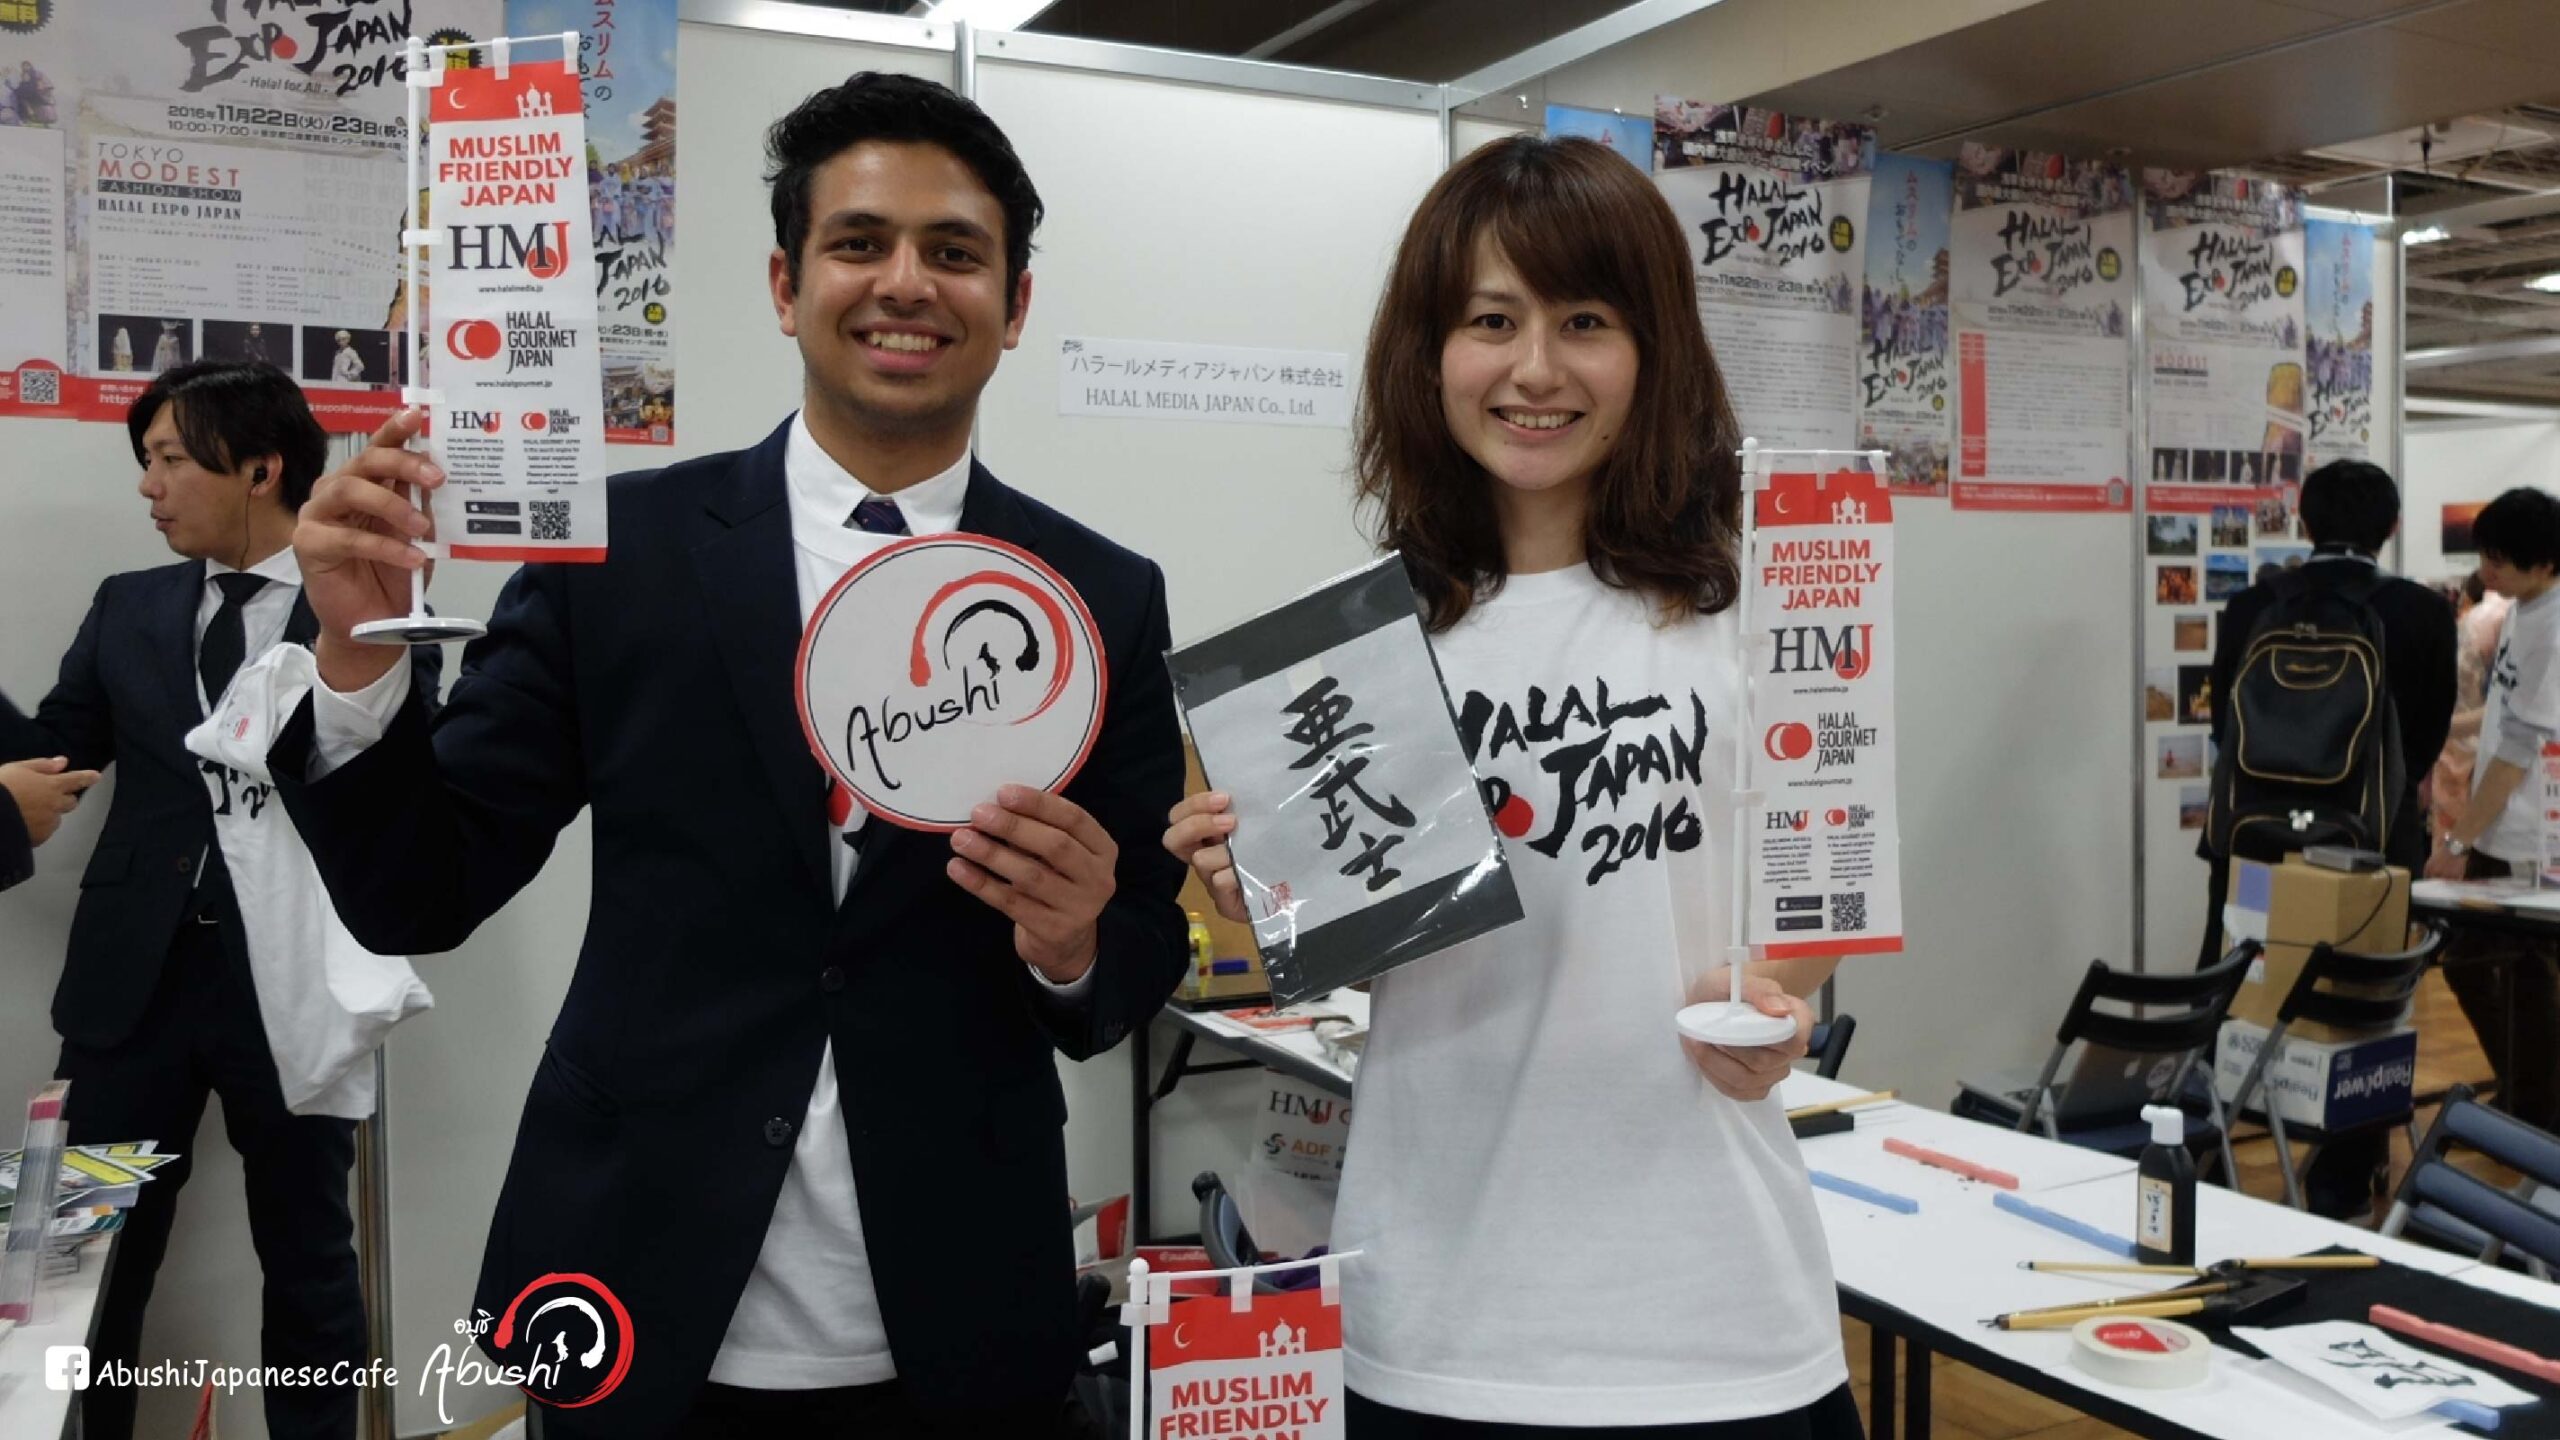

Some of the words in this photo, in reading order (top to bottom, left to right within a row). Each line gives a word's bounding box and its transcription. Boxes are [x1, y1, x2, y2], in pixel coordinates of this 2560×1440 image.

[293, 0, 412, 75] JAPAN
[284, 79, 302, 92] for
[97, 142, 185, 162] TOKYO
[450, 133, 561, 158] MUSLIM
[97, 159, 241, 188] MODEST
[439, 157, 573, 182] FRIENDLY
[98, 180, 182, 199] FASHION
[187, 187, 241, 202] SHOW
[461, 183, 556, 207] JAPAN
[1709, 171, 1807, 215] HALAL
[98, 198, 145, 214] HALAL
[152, 201, 190, 217] EXPO
[196, 205, 242, 221] JAPAN
[1758, 188, 1822, 249] JAPAN
[1998, 210, 2080, 250] HALAL
[448, 221, 571, 279] HMJ
[1778, 232, 1825, 266] 2016
[595, 231, 667, 297] JAPAN
[614, 274, 671, 311] 2016
[506, 311, 555, 329] HALAL
[507, 329, 577, 348] GOURMET
[506, 349, 553, 374] JAPAN
[1086, 387, 1142, 407] HALAL
[1146, 391, 1199, 410] MEDIA
[1204, 394, 1254, 412] JAPAN
[450, 410, 501, 434] HMJ
[1772, 539, 1870, 563] MUSLIM
[1763, 563, 1882, 587] FRIENDLY
[1782, 587, 1860, 611] JAPAN
[1769, 624, 1874, 680] HMJ
[847, 665, 1001, 790] Abushi
[1818, 712, 1858, 730] HALAL
[1818, 728, 1877, 748] GOURMET
[1525, 686, 1708, 859] JAPAN
[1814, 749, 1855, 773] JAPAN
[1766, 810, 1809, 831] HMJ
[1581, 797, 1702, 887] 2016
[1269, 1089, 1334, 1125] HMJ
[1172, 1371, 1313, 1410] MUSLIM
[1160, 1398, 1328, 1440] FRIENDLY
